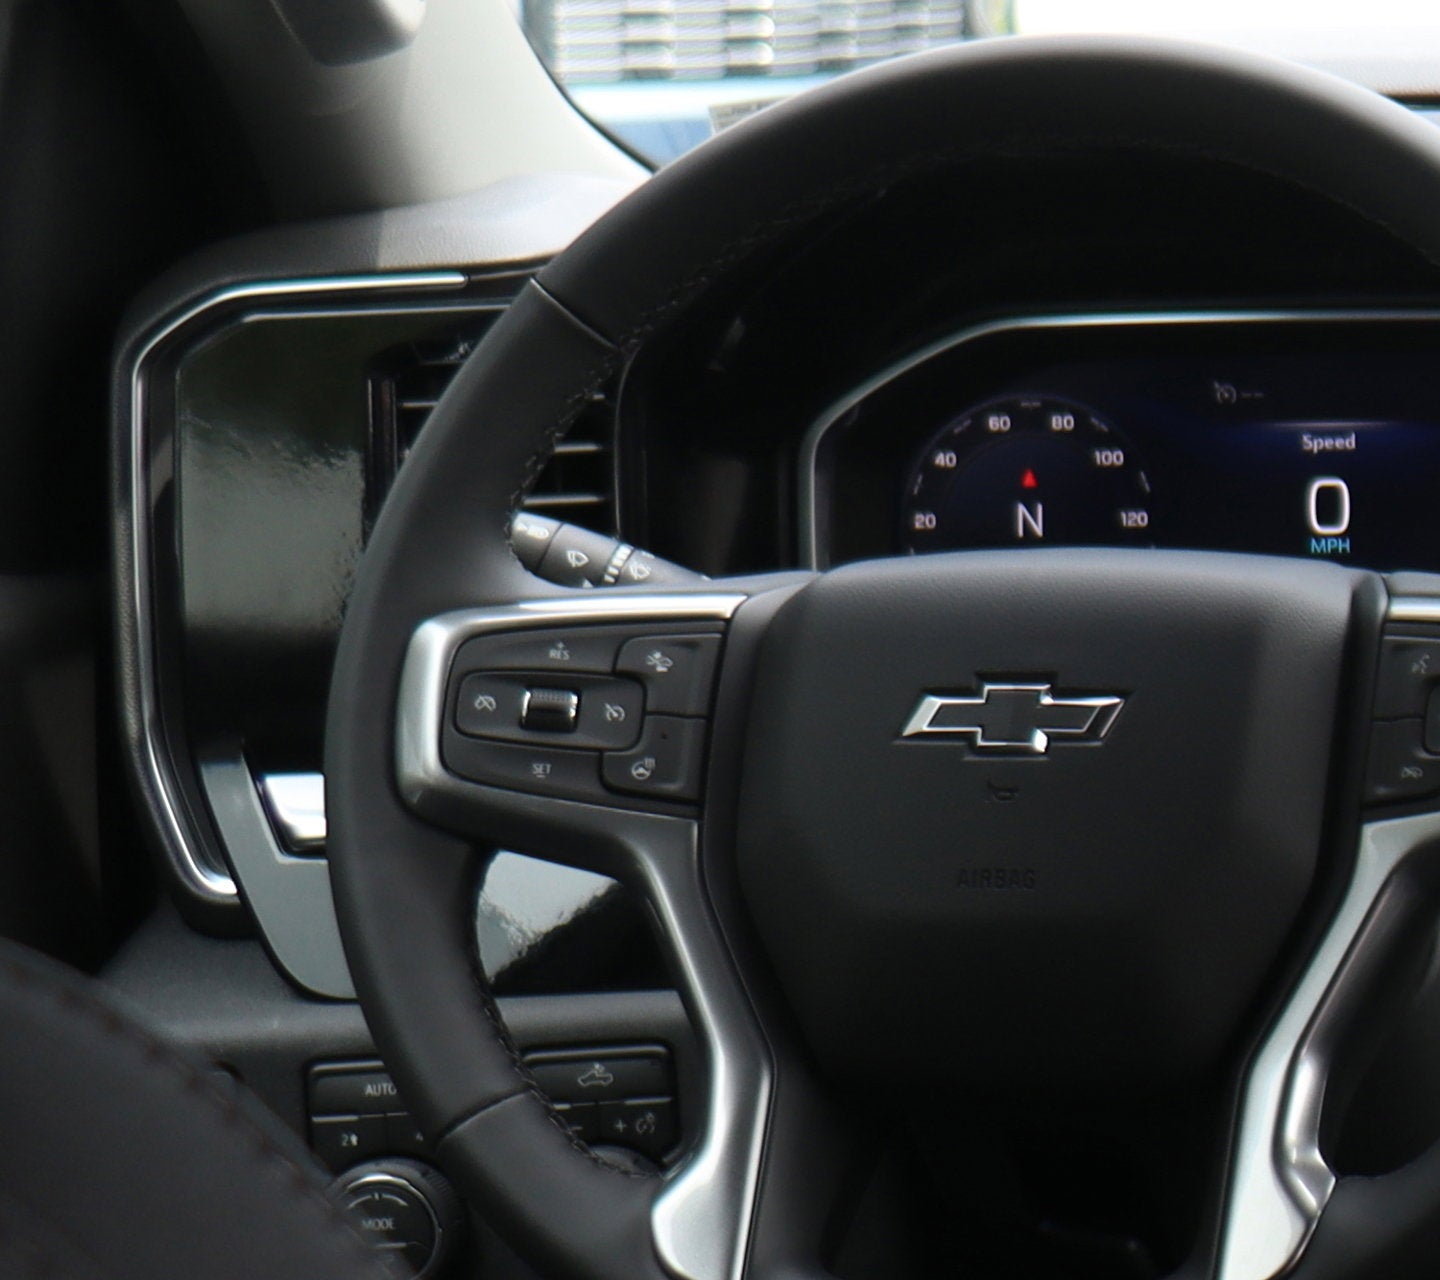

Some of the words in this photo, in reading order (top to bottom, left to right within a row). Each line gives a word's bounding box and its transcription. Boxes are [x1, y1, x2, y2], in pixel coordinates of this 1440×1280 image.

[988, 414, 1011, 432] 60
[1051, 414, 1075, 431] 80
[1302, 432, 1356, 454] Speed
[933, 450, 957, 468] 40
[1093, 449, 1124, 467] 100
[1309, 477, 1350, 535] 0
[914, 513, 937, 530] 20
[1016, 501, 1044, 538] N
[1120, 510, 1148, 527] 120
[1310, 538, 1350, 554] MPH
[548, 649, 570, 661] RES
[531, 763, 552, 775] SET
[365, 1083, 397, 1096] AUTO
